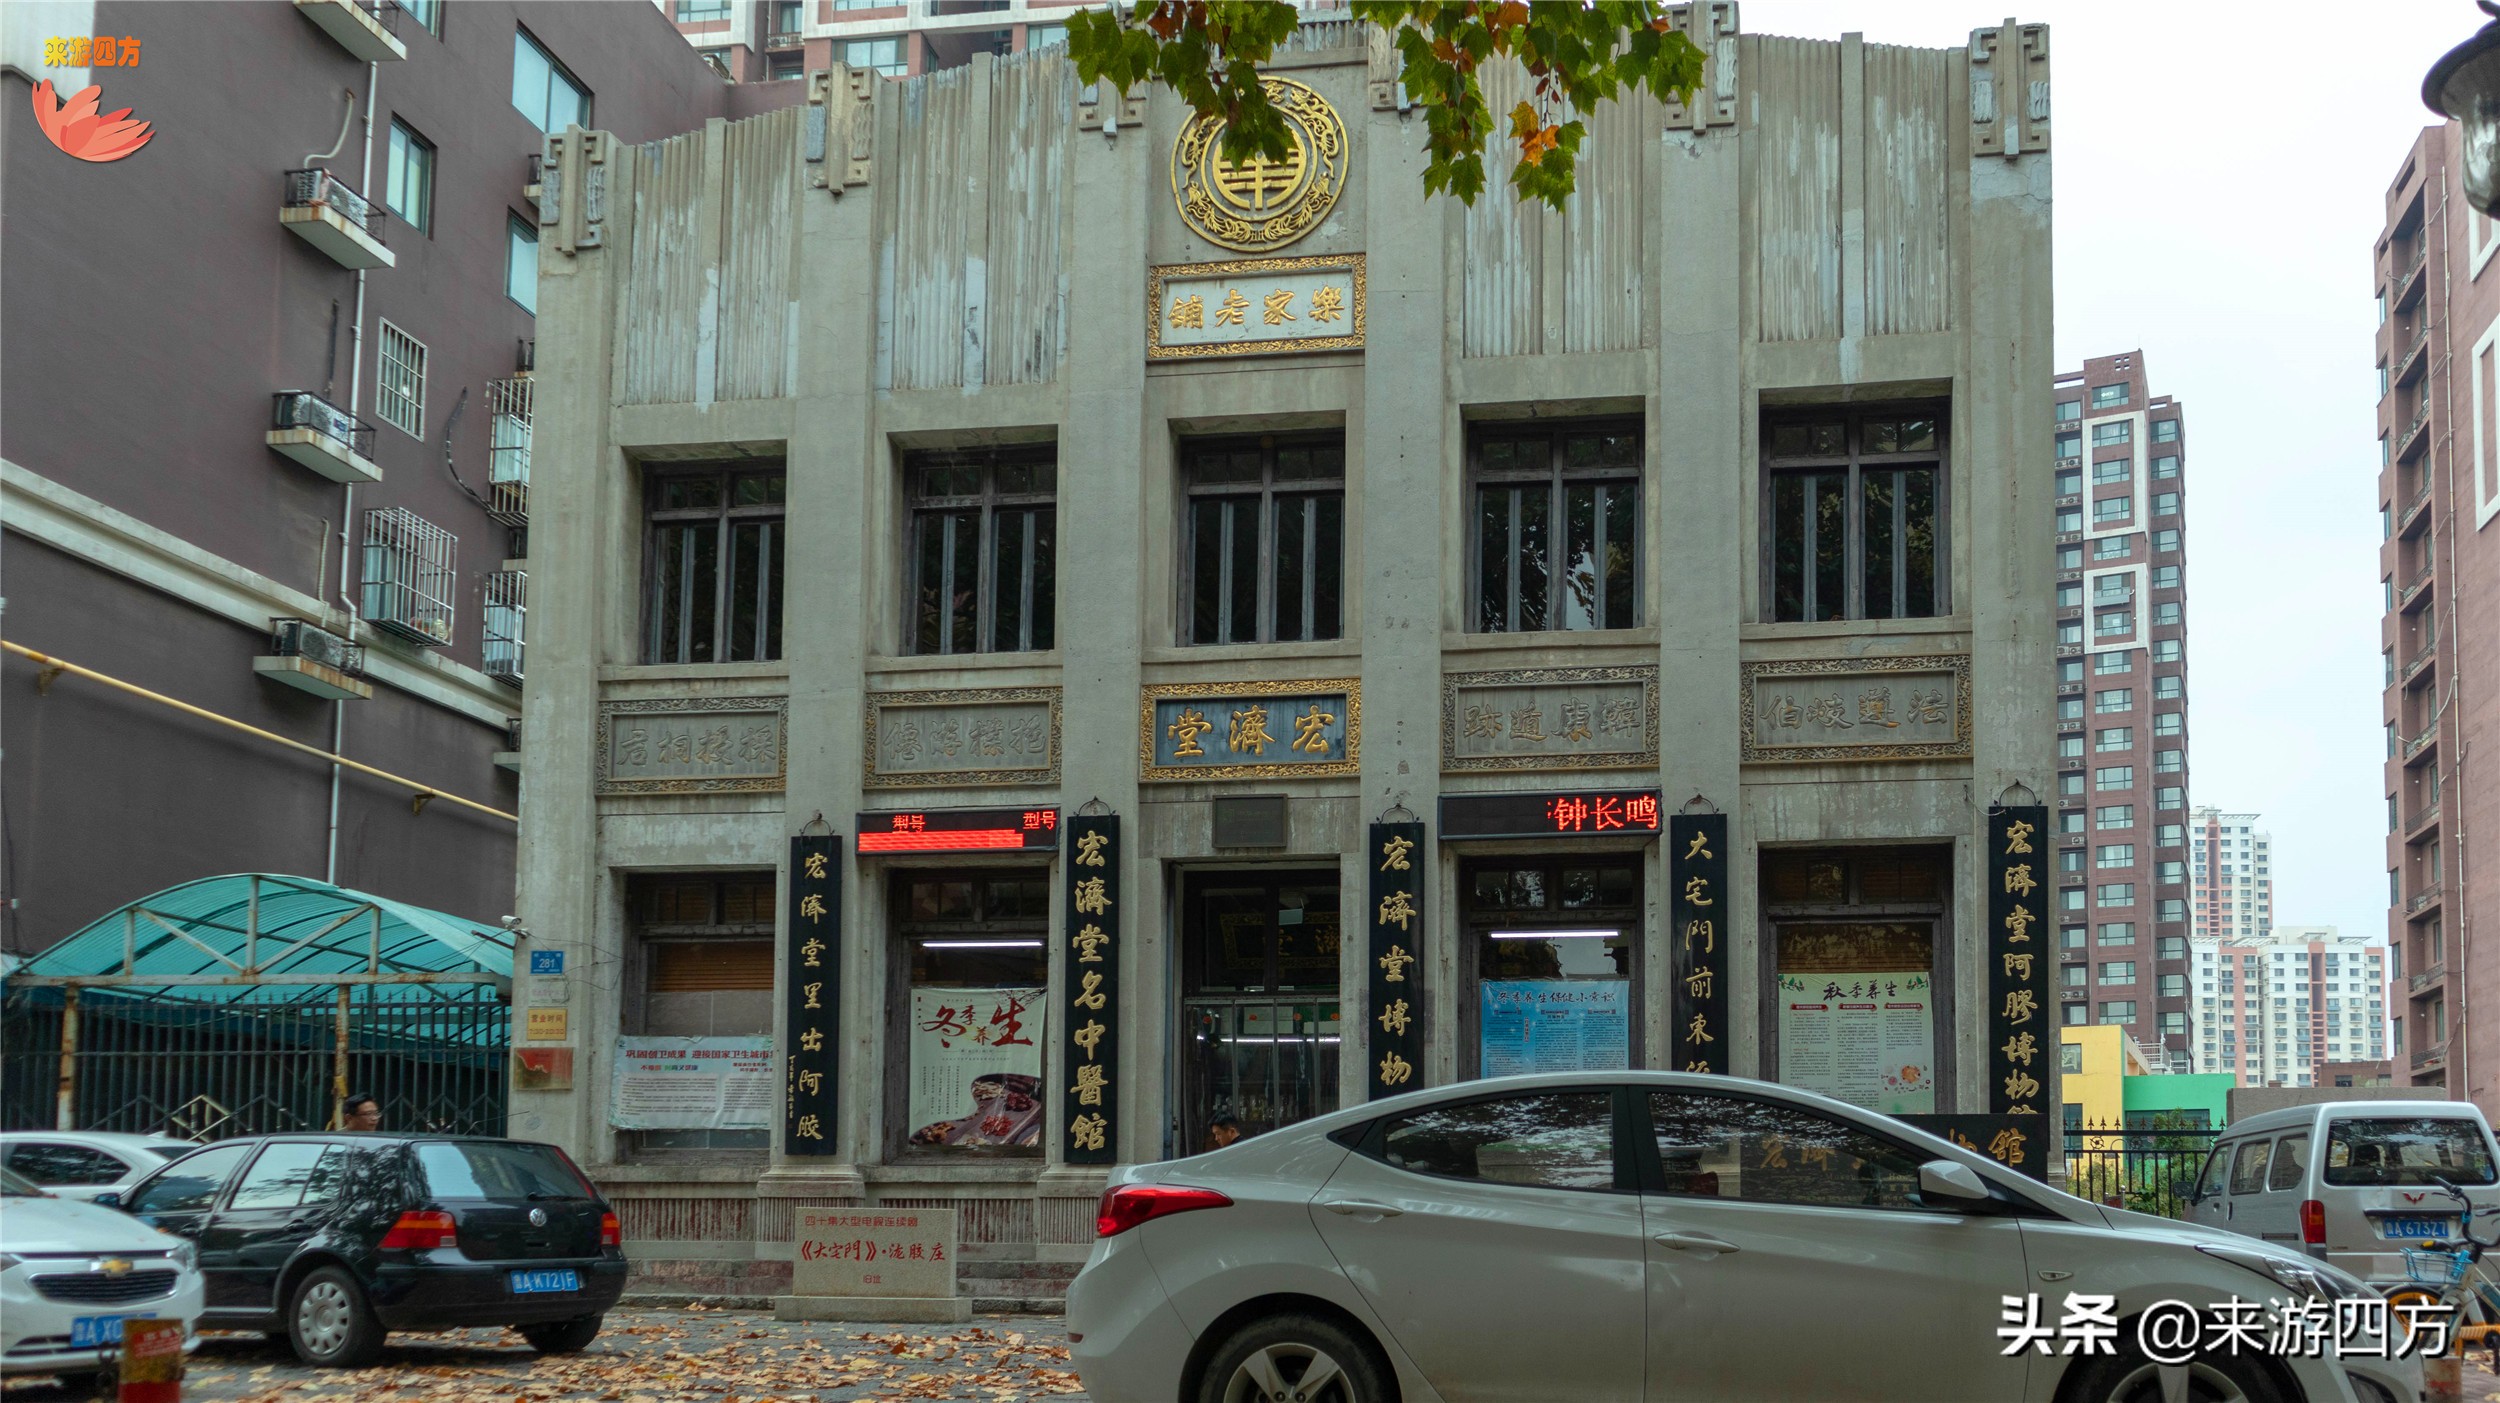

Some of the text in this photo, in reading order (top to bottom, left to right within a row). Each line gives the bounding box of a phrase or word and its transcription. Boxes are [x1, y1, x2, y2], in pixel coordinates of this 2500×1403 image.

[1548, 795, 1657, 831] 钟长鸣
[1022, 811, 1056, 830] 型号
[538, 958, 555, 968] 281
[2002, 820, 2039, 1114] 宏濟堂阿膠博物
[1498, 991, 1615, 1004] 冬季养生保健小常识
[805, 1216, 918, 1228] 四十集大型电视连续剧
[863, 1275, 881, 1284] 旧址
